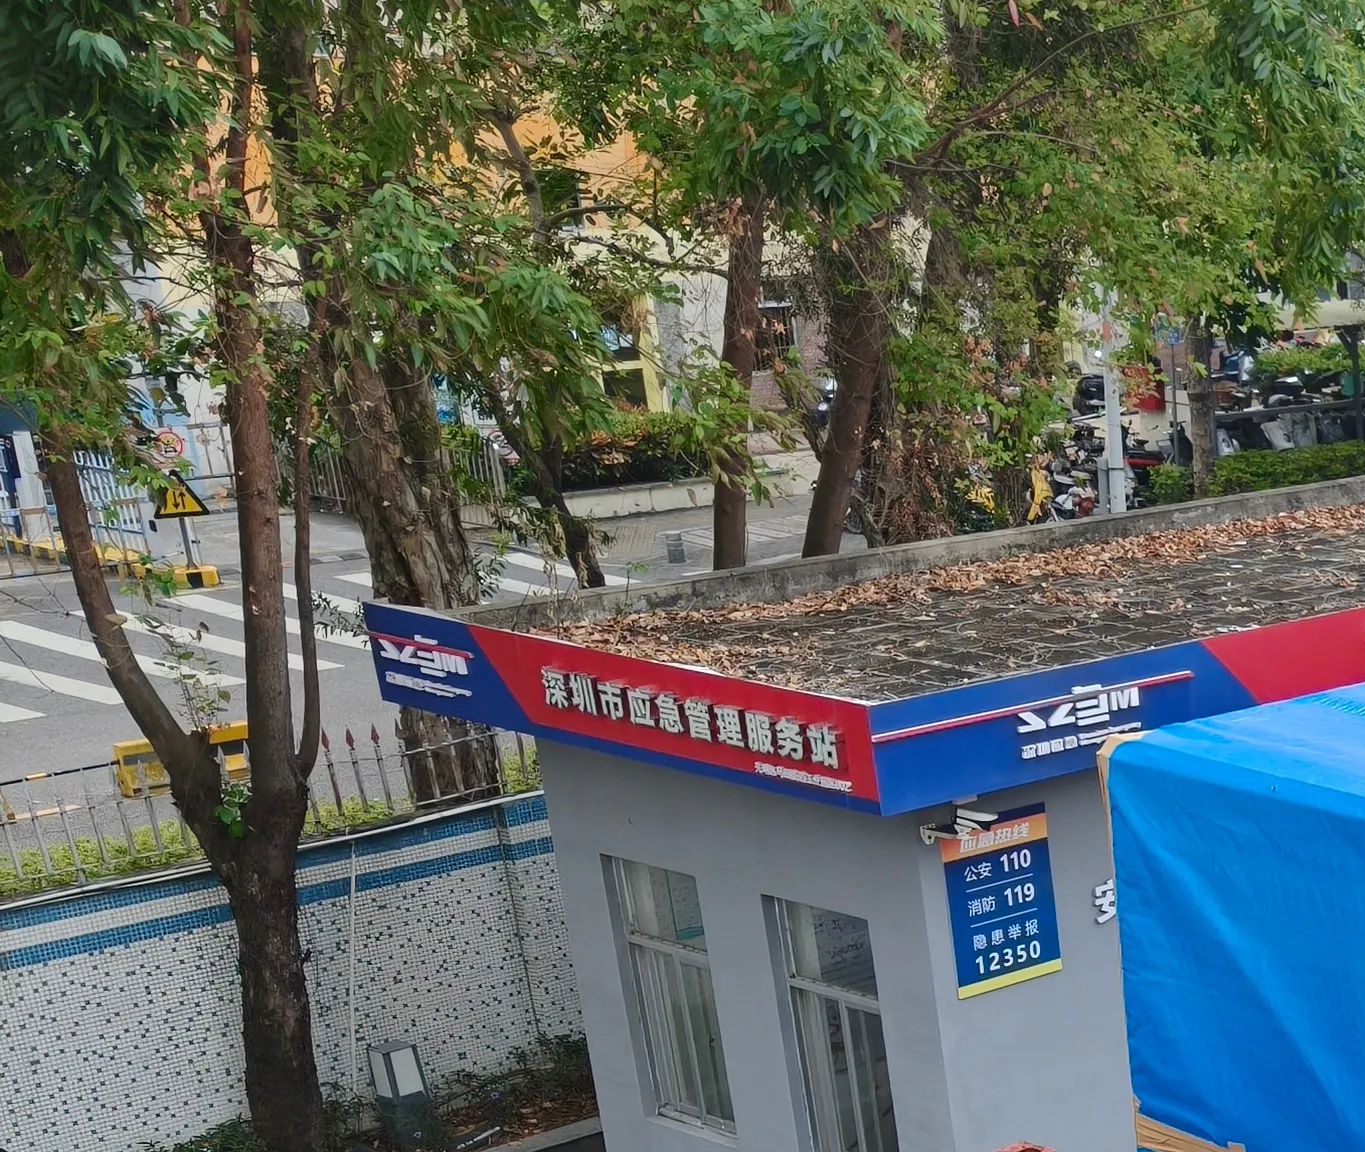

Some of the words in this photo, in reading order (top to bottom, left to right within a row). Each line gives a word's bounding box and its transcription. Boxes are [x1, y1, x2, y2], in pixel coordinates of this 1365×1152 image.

[541, 666, 839, 770] 深圳市应急管理服务站
[964, 861, 993, 882] 公安
[1000, 849, 1031, 873] 110
[968, 895, 996, 917] 消防
[1004, 883, 1035, 907] 119
[973, 919, 1039, 951] 隐患举报
[975, 940, 1041, 974] 12350
